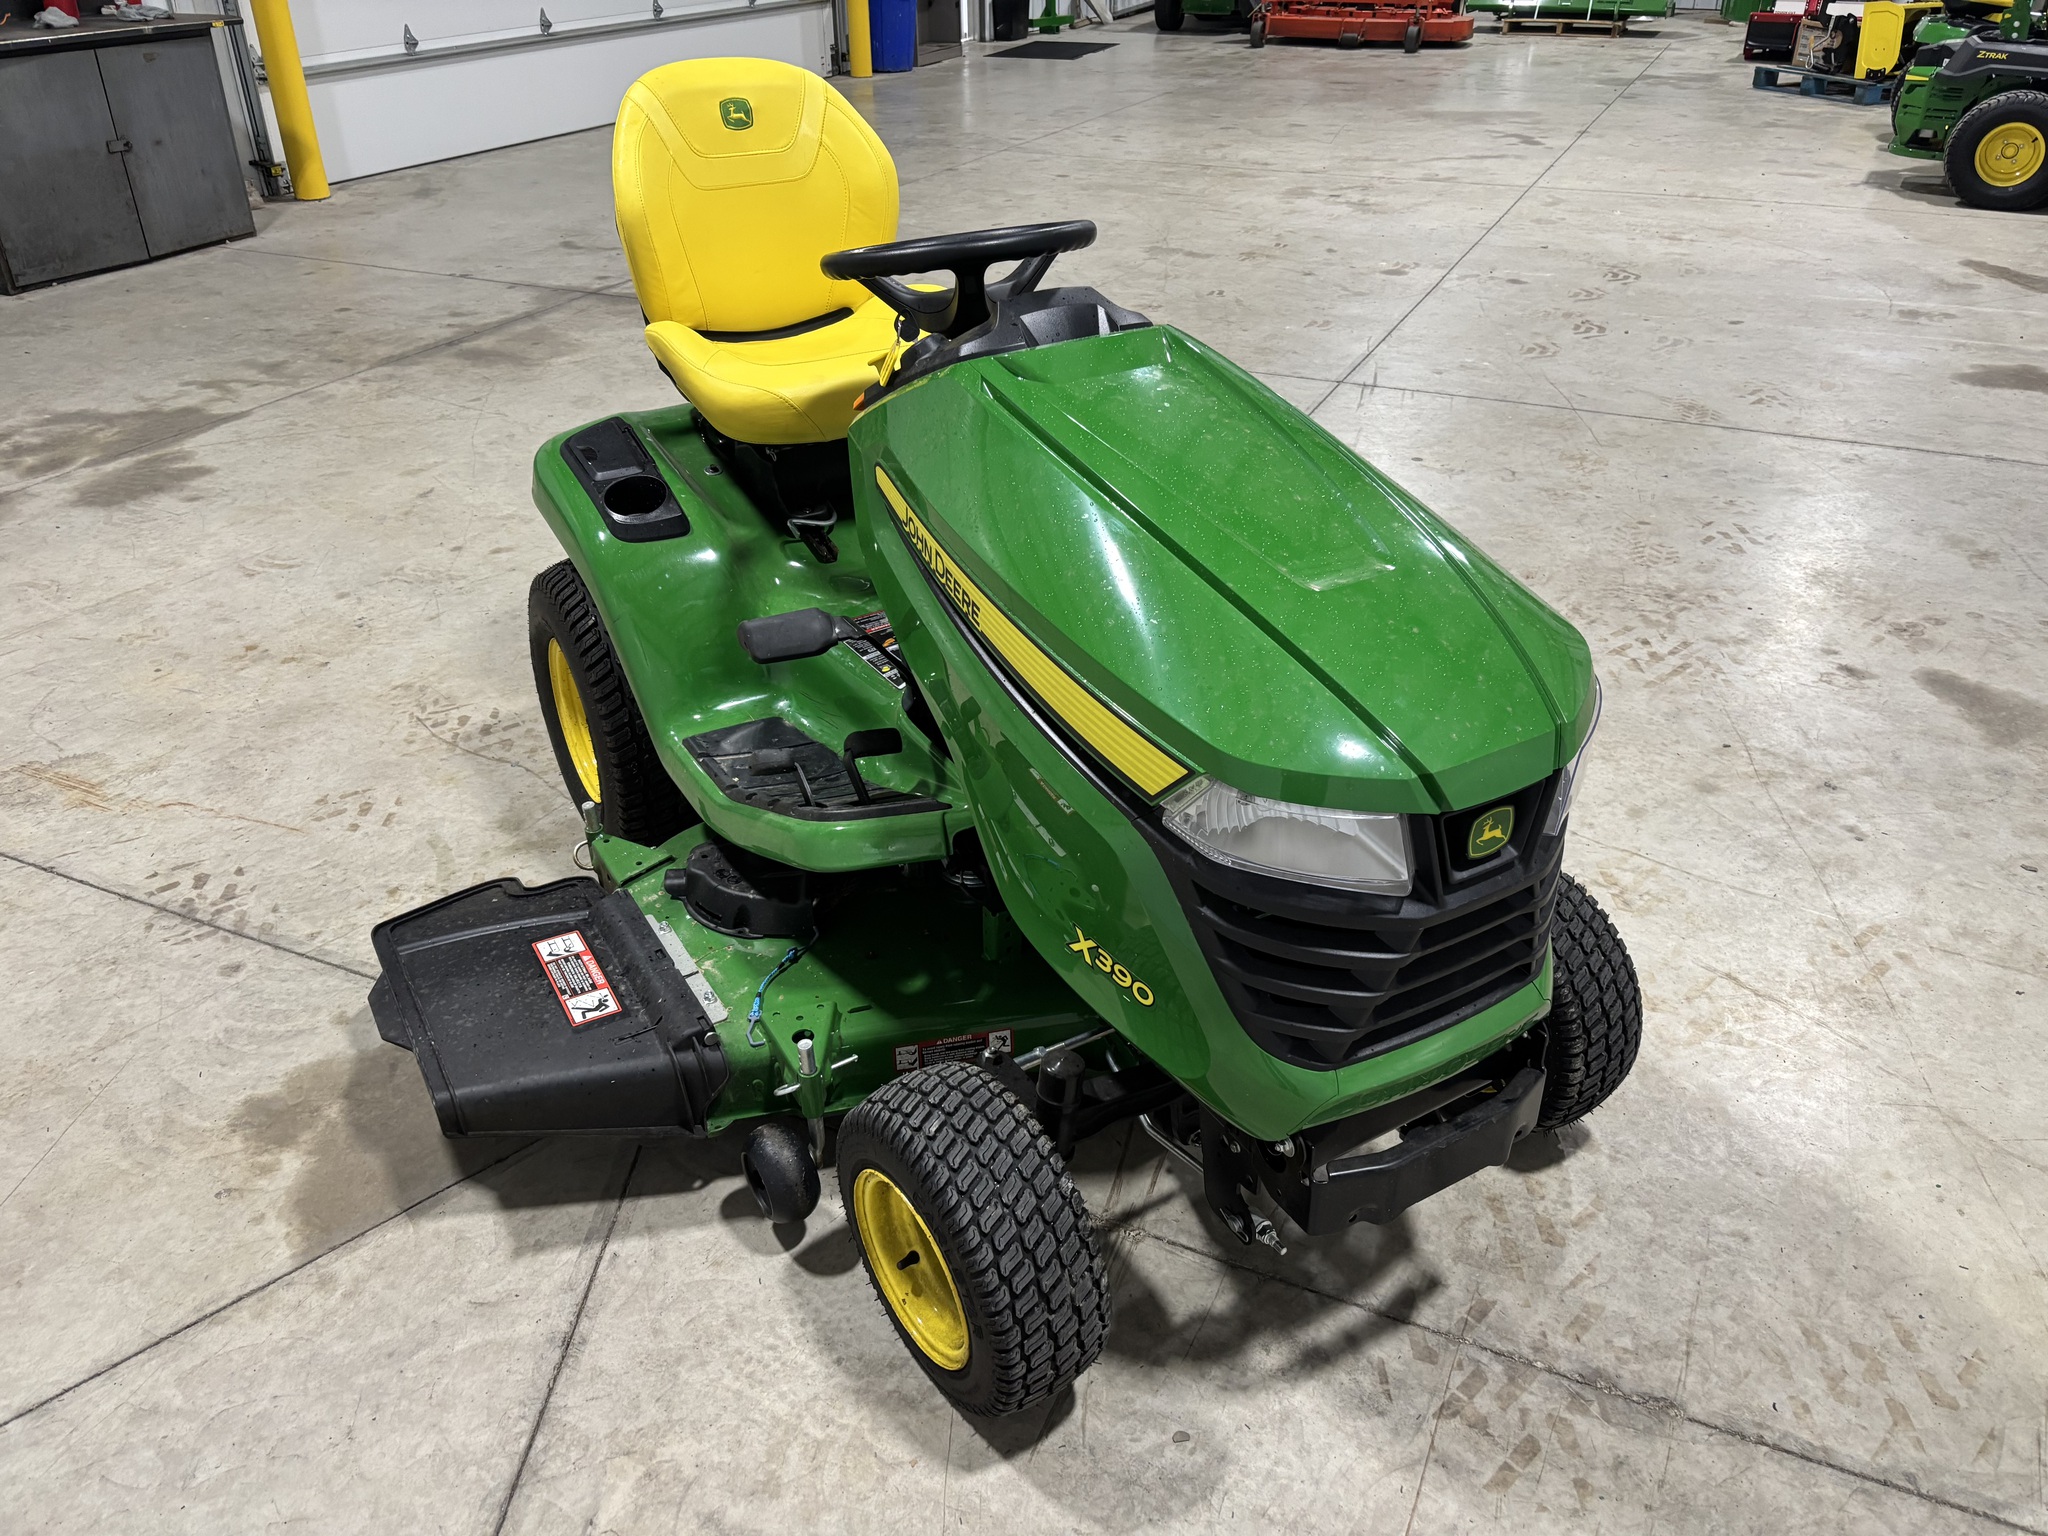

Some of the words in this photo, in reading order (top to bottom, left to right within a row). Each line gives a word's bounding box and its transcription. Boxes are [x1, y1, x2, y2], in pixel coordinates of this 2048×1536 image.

[1976, 50, 2009, 60] ZTRAK
[901, 505, 933, 567] JOHN
[934, 548, 981, 628] DEERE
[586, 960, 606, 985] DANGER
[1067, 924, 1155, 1006] X390
[943, 1034, 973, 1044] DANGER
